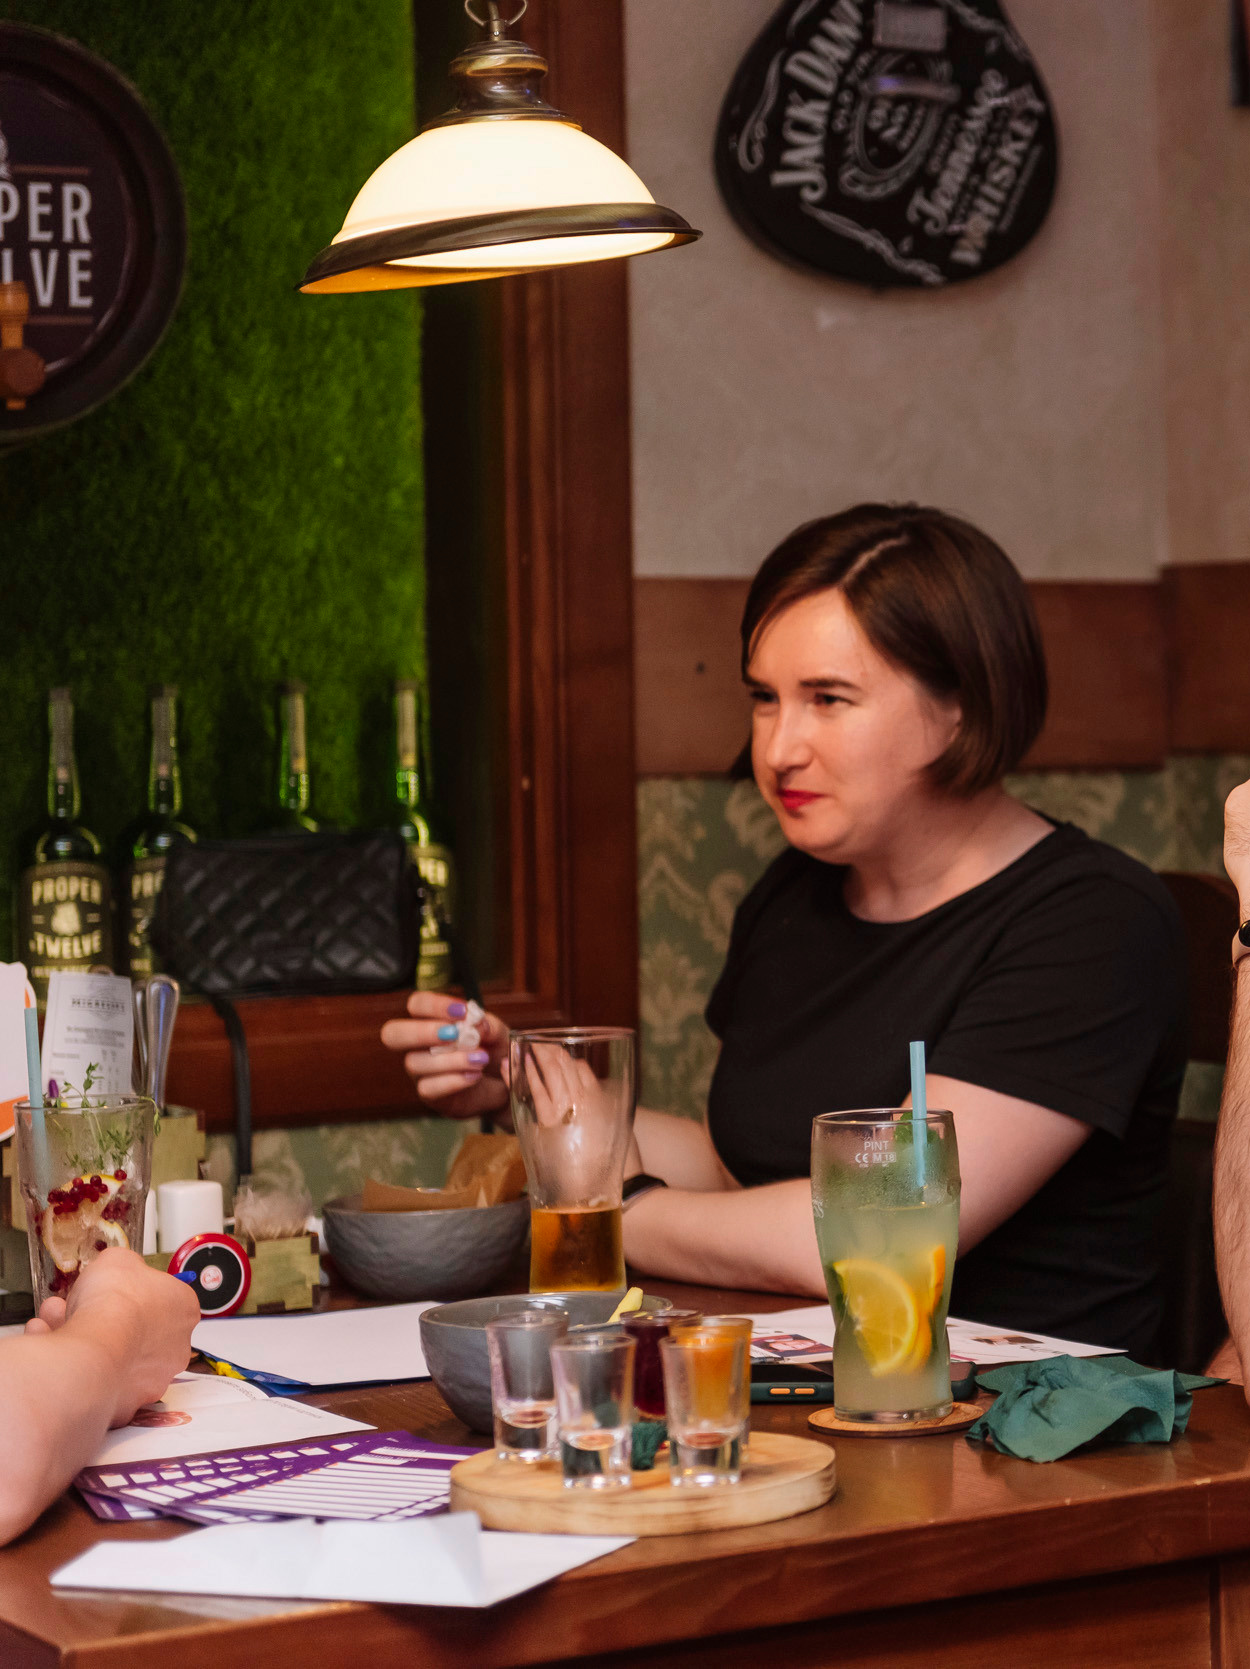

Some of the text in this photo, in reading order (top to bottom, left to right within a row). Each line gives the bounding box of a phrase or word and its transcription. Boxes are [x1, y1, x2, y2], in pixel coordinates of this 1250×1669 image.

[769, 90, 831, 202] JACK
[33, 929, 102, 960] TWELVE
[864, 1140, 889, 1151] PINT
